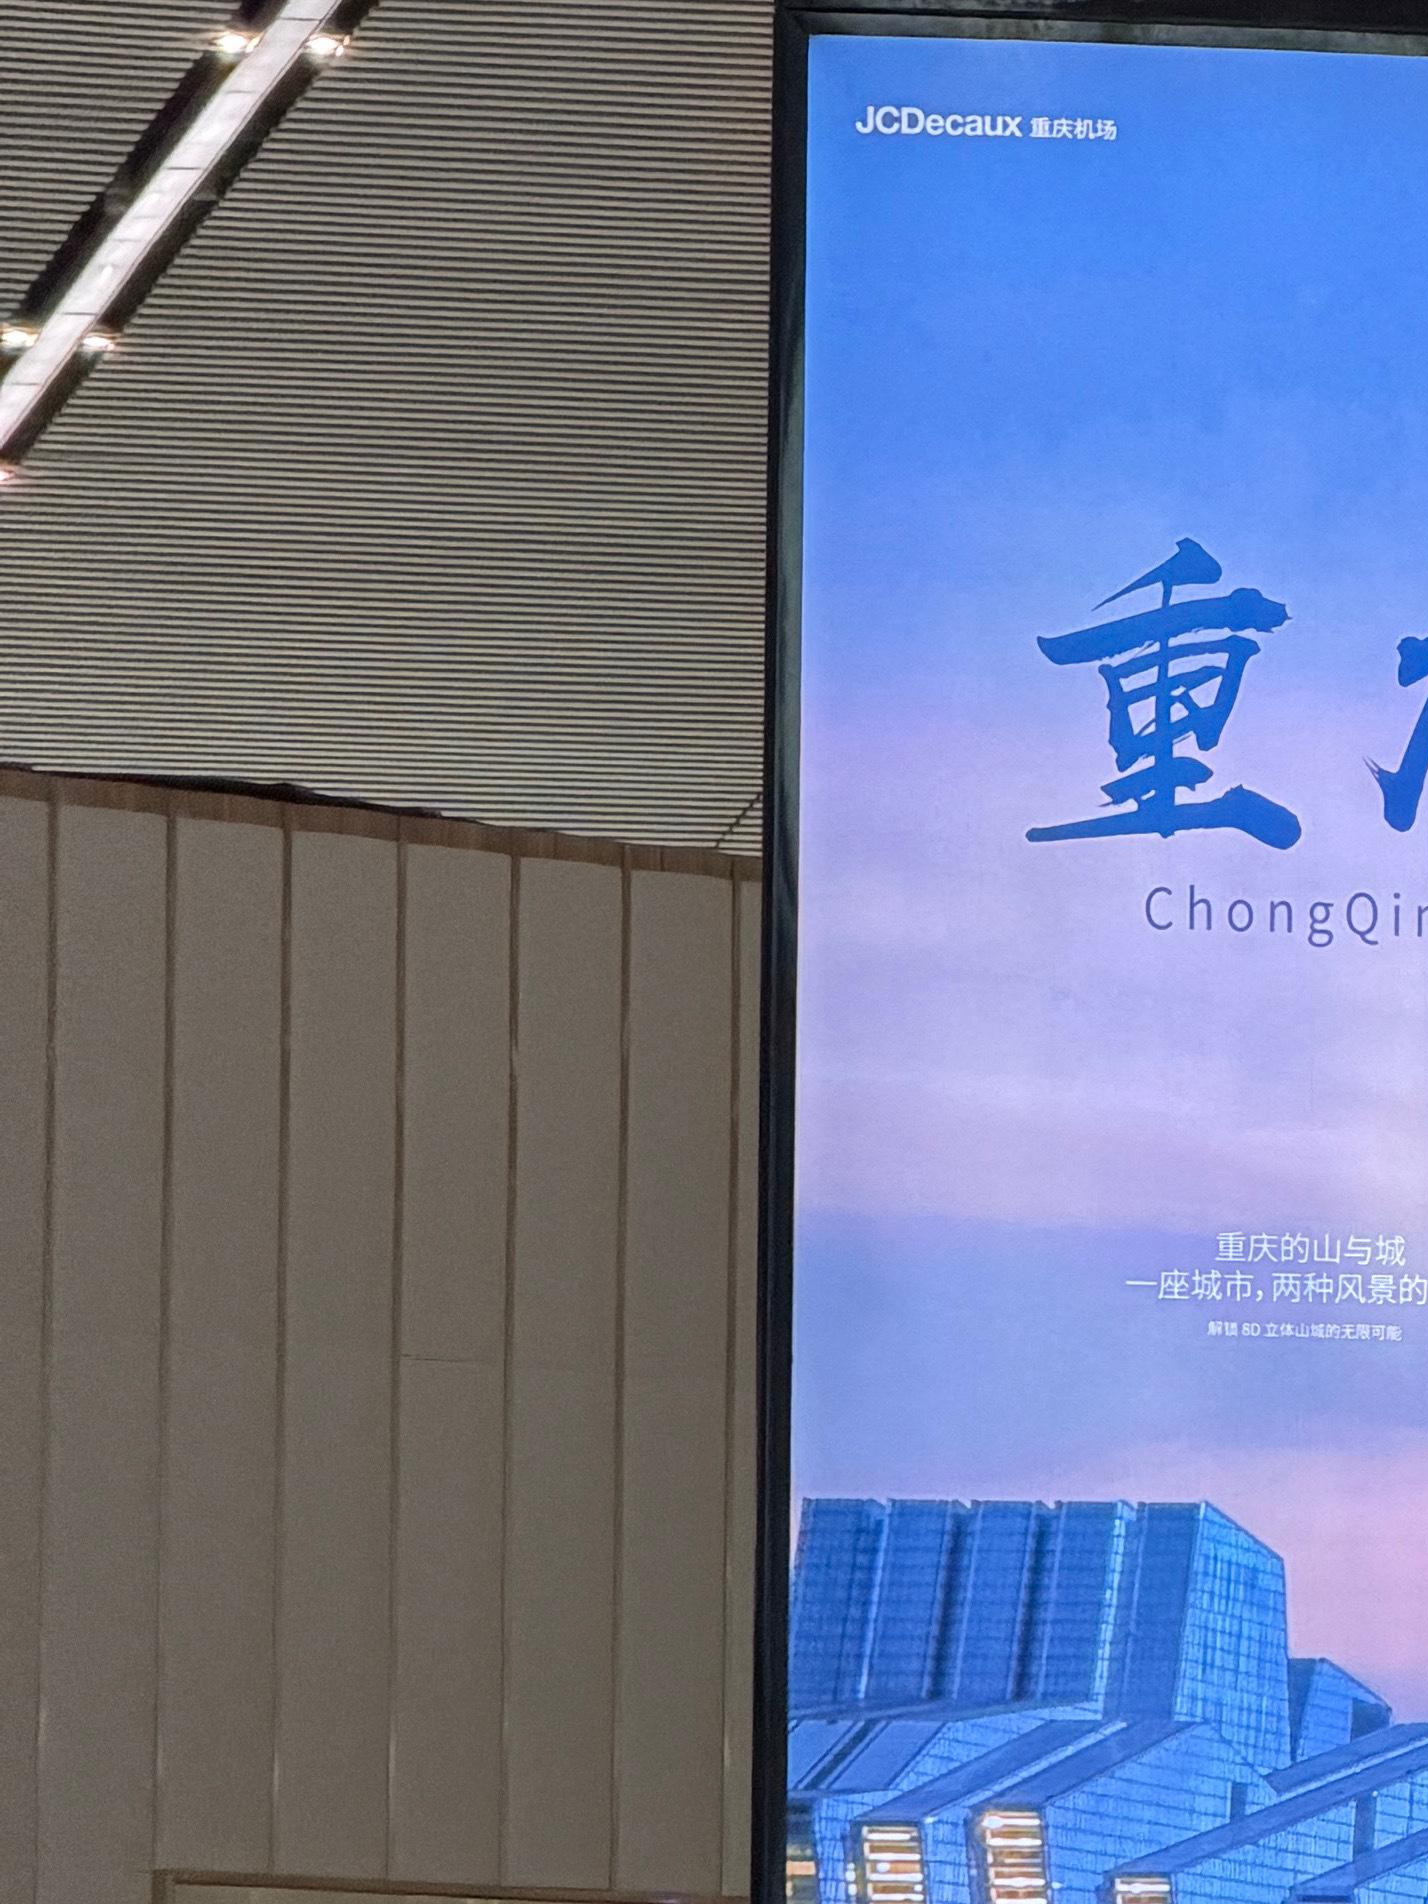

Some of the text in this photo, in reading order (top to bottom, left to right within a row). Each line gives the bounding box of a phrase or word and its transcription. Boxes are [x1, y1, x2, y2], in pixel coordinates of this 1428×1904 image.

[855, 105, 1118, 141] JCDecaux 重庆机场
[1214, 1230, 1406, 1266] 重庆的山与城
[1207, 1320, 1238, 1338] 解锁
[1265, 1322, 1402, 1342] 立体山城的无限可能
